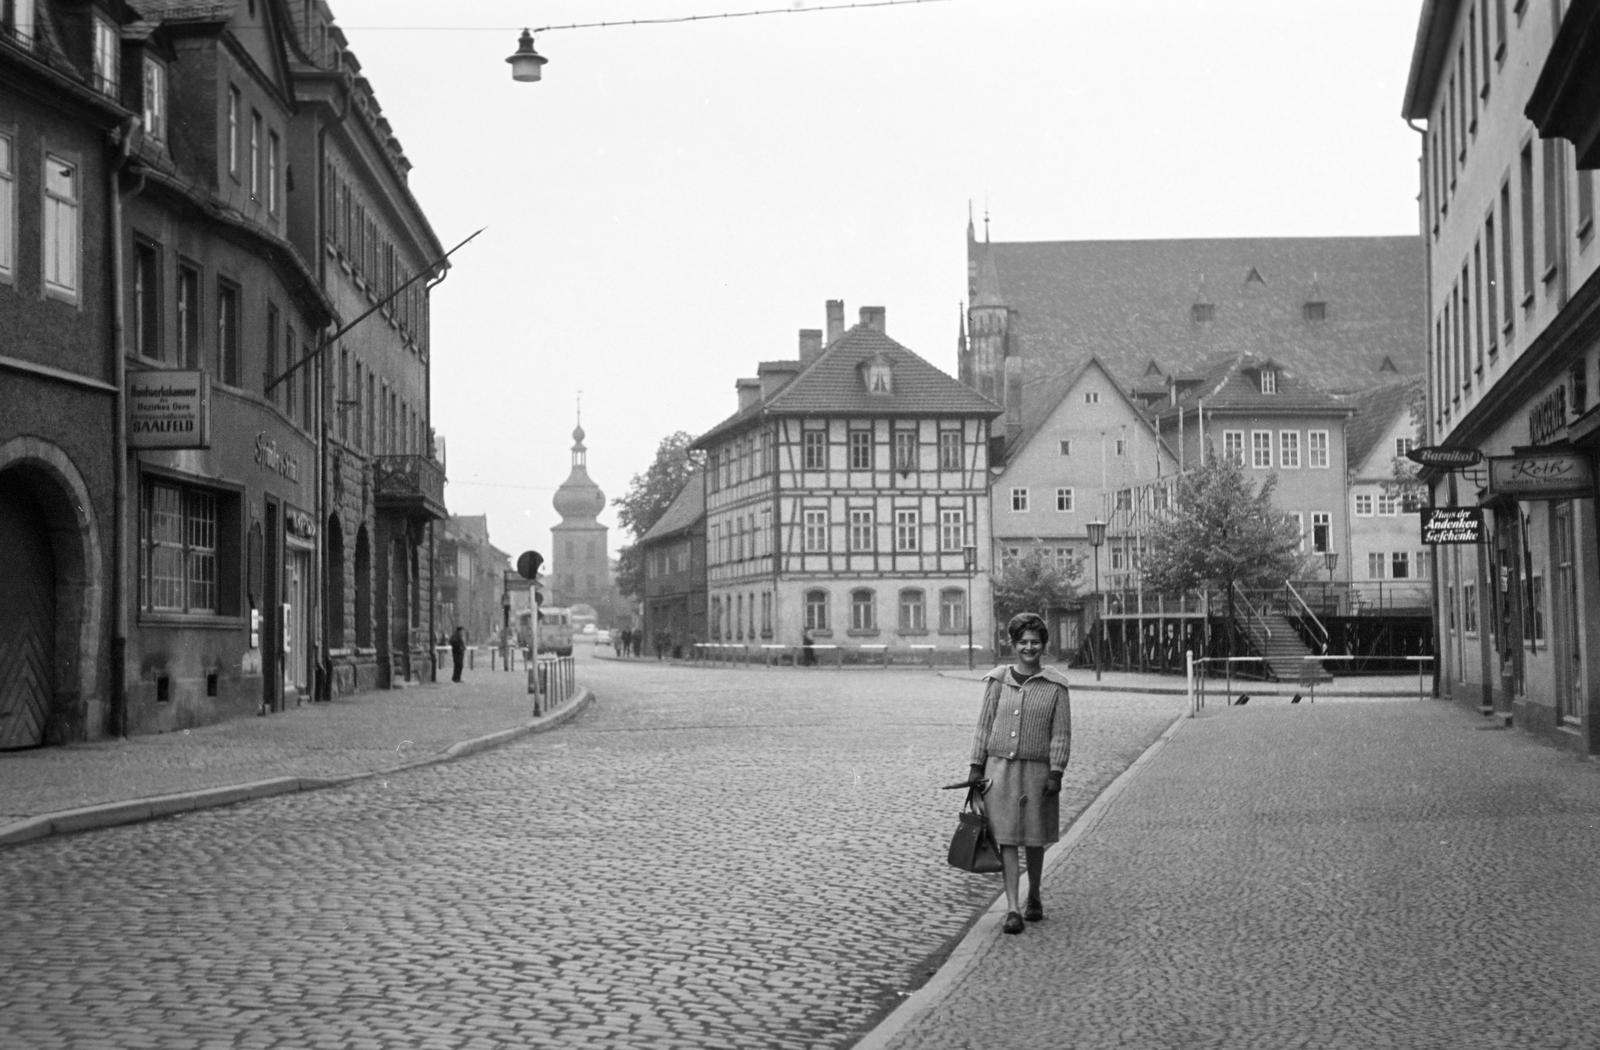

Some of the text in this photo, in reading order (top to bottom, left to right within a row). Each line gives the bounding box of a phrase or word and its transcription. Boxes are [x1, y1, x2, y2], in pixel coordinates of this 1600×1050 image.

[133, 420, 193, 432] SAALFELD
[1457, 509, 1471, 518] der
[1424, 518, 1478, 529] Andenken
